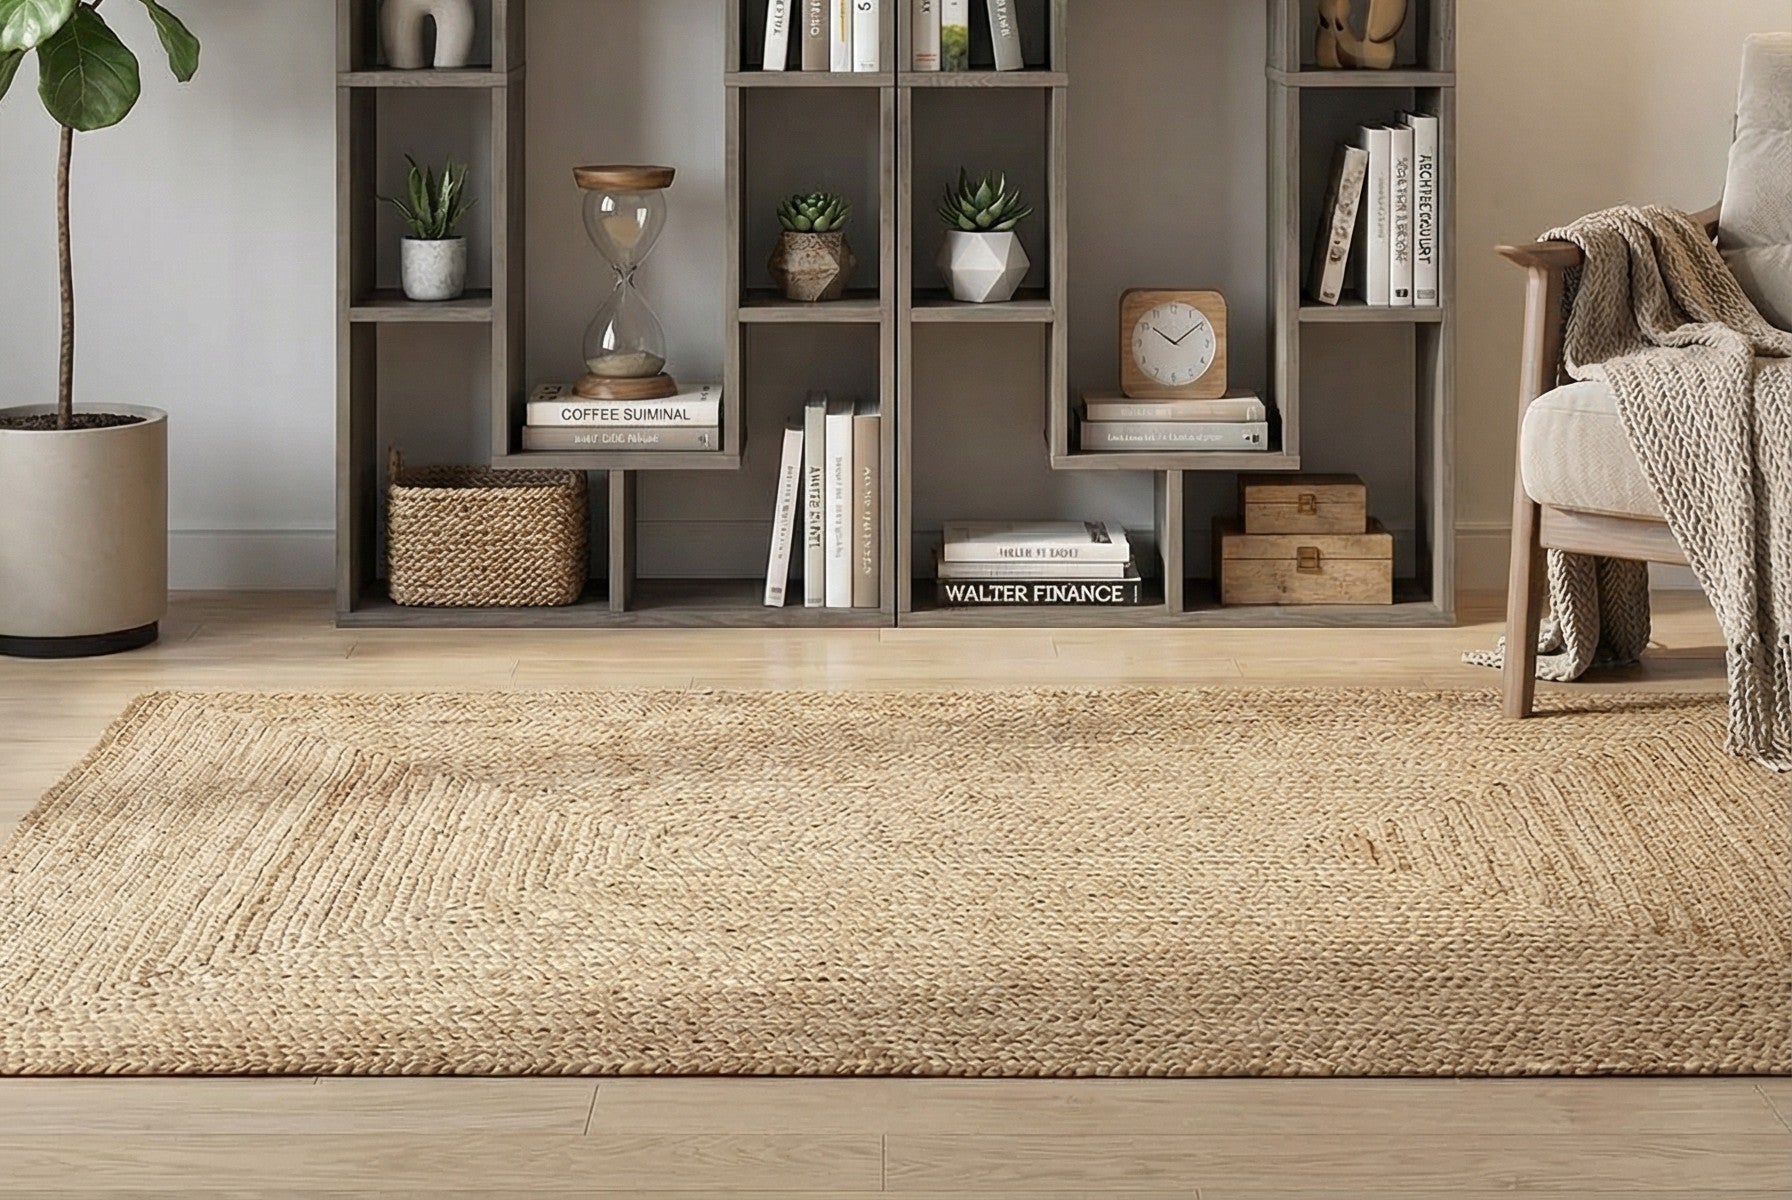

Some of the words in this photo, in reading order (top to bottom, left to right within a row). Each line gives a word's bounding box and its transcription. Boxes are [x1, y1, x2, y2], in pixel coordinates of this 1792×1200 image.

[561, 408, 620, 421] COFFEE
[623, 408, 691, 421] SUIMINAL
[945, 584, 1029, 602] WALTER
[1033, 584, 1124, 602] FINANCE
